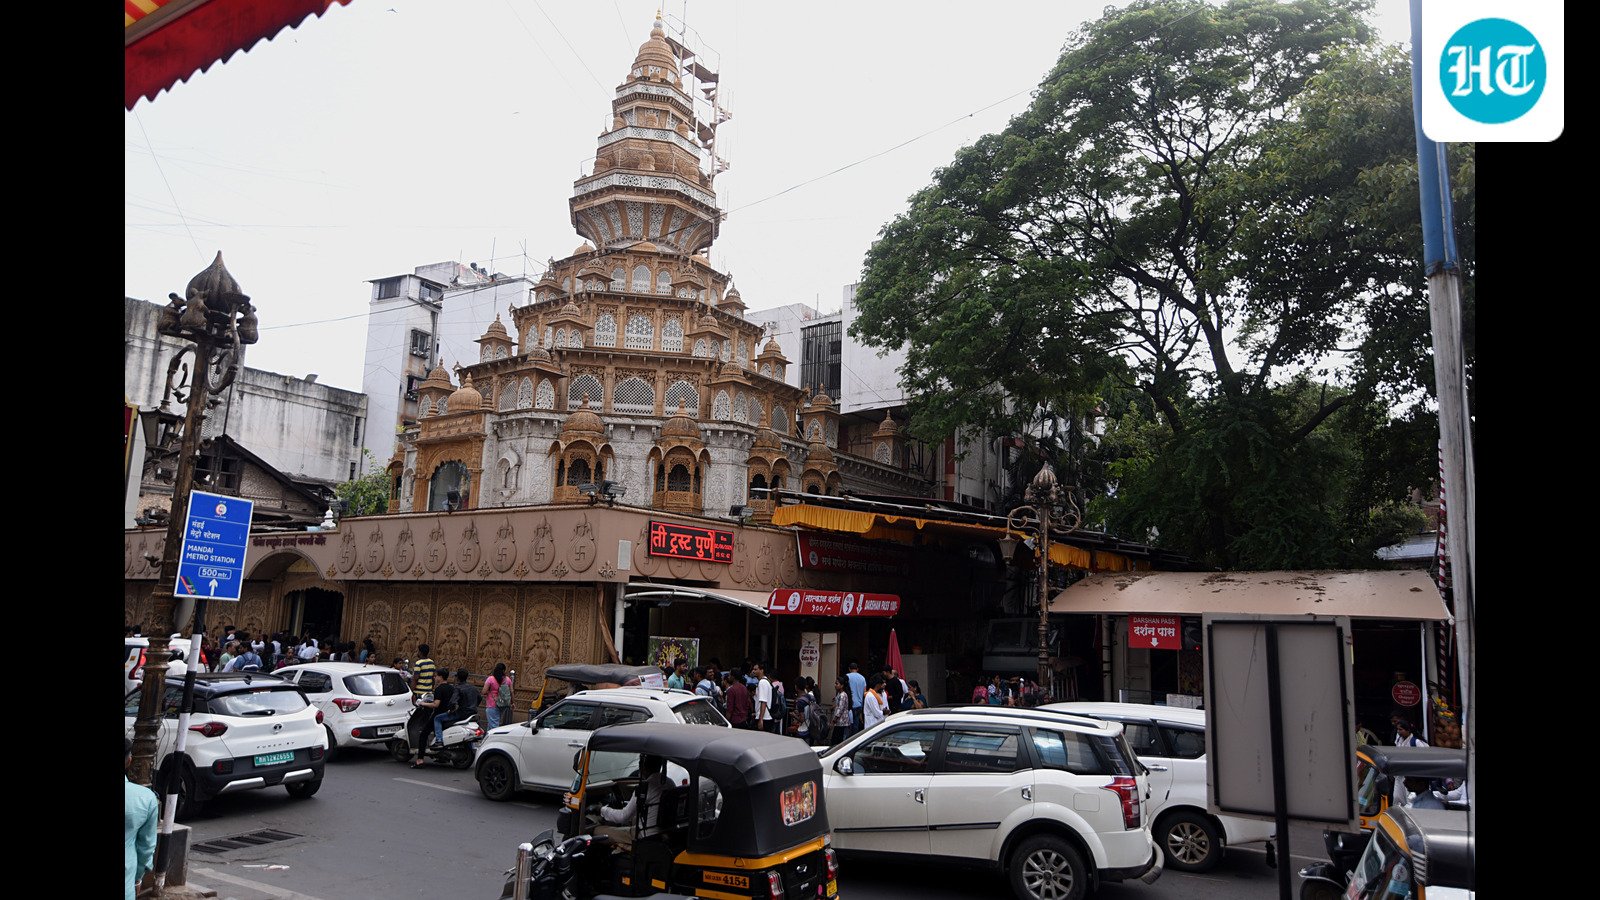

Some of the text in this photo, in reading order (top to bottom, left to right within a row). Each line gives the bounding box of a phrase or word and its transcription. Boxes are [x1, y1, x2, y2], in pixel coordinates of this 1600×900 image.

[191, 519, 206, 530] मंडई
[190, 529, 221, 540] मेट्रो स्टेशन
[652, 524, 714, 558] ती ट्रस्ट पुणे
[187, 544, 214, 554] MANDAI
[186, 552, 236, 564] METRO STATION
[201, 568, 218, 577] 500
[1133, 616, 1160, 624] DARSHAN
[1133, 623, 1176, 637] दर्शन पास
[722, 875, 747, 887] 4154
